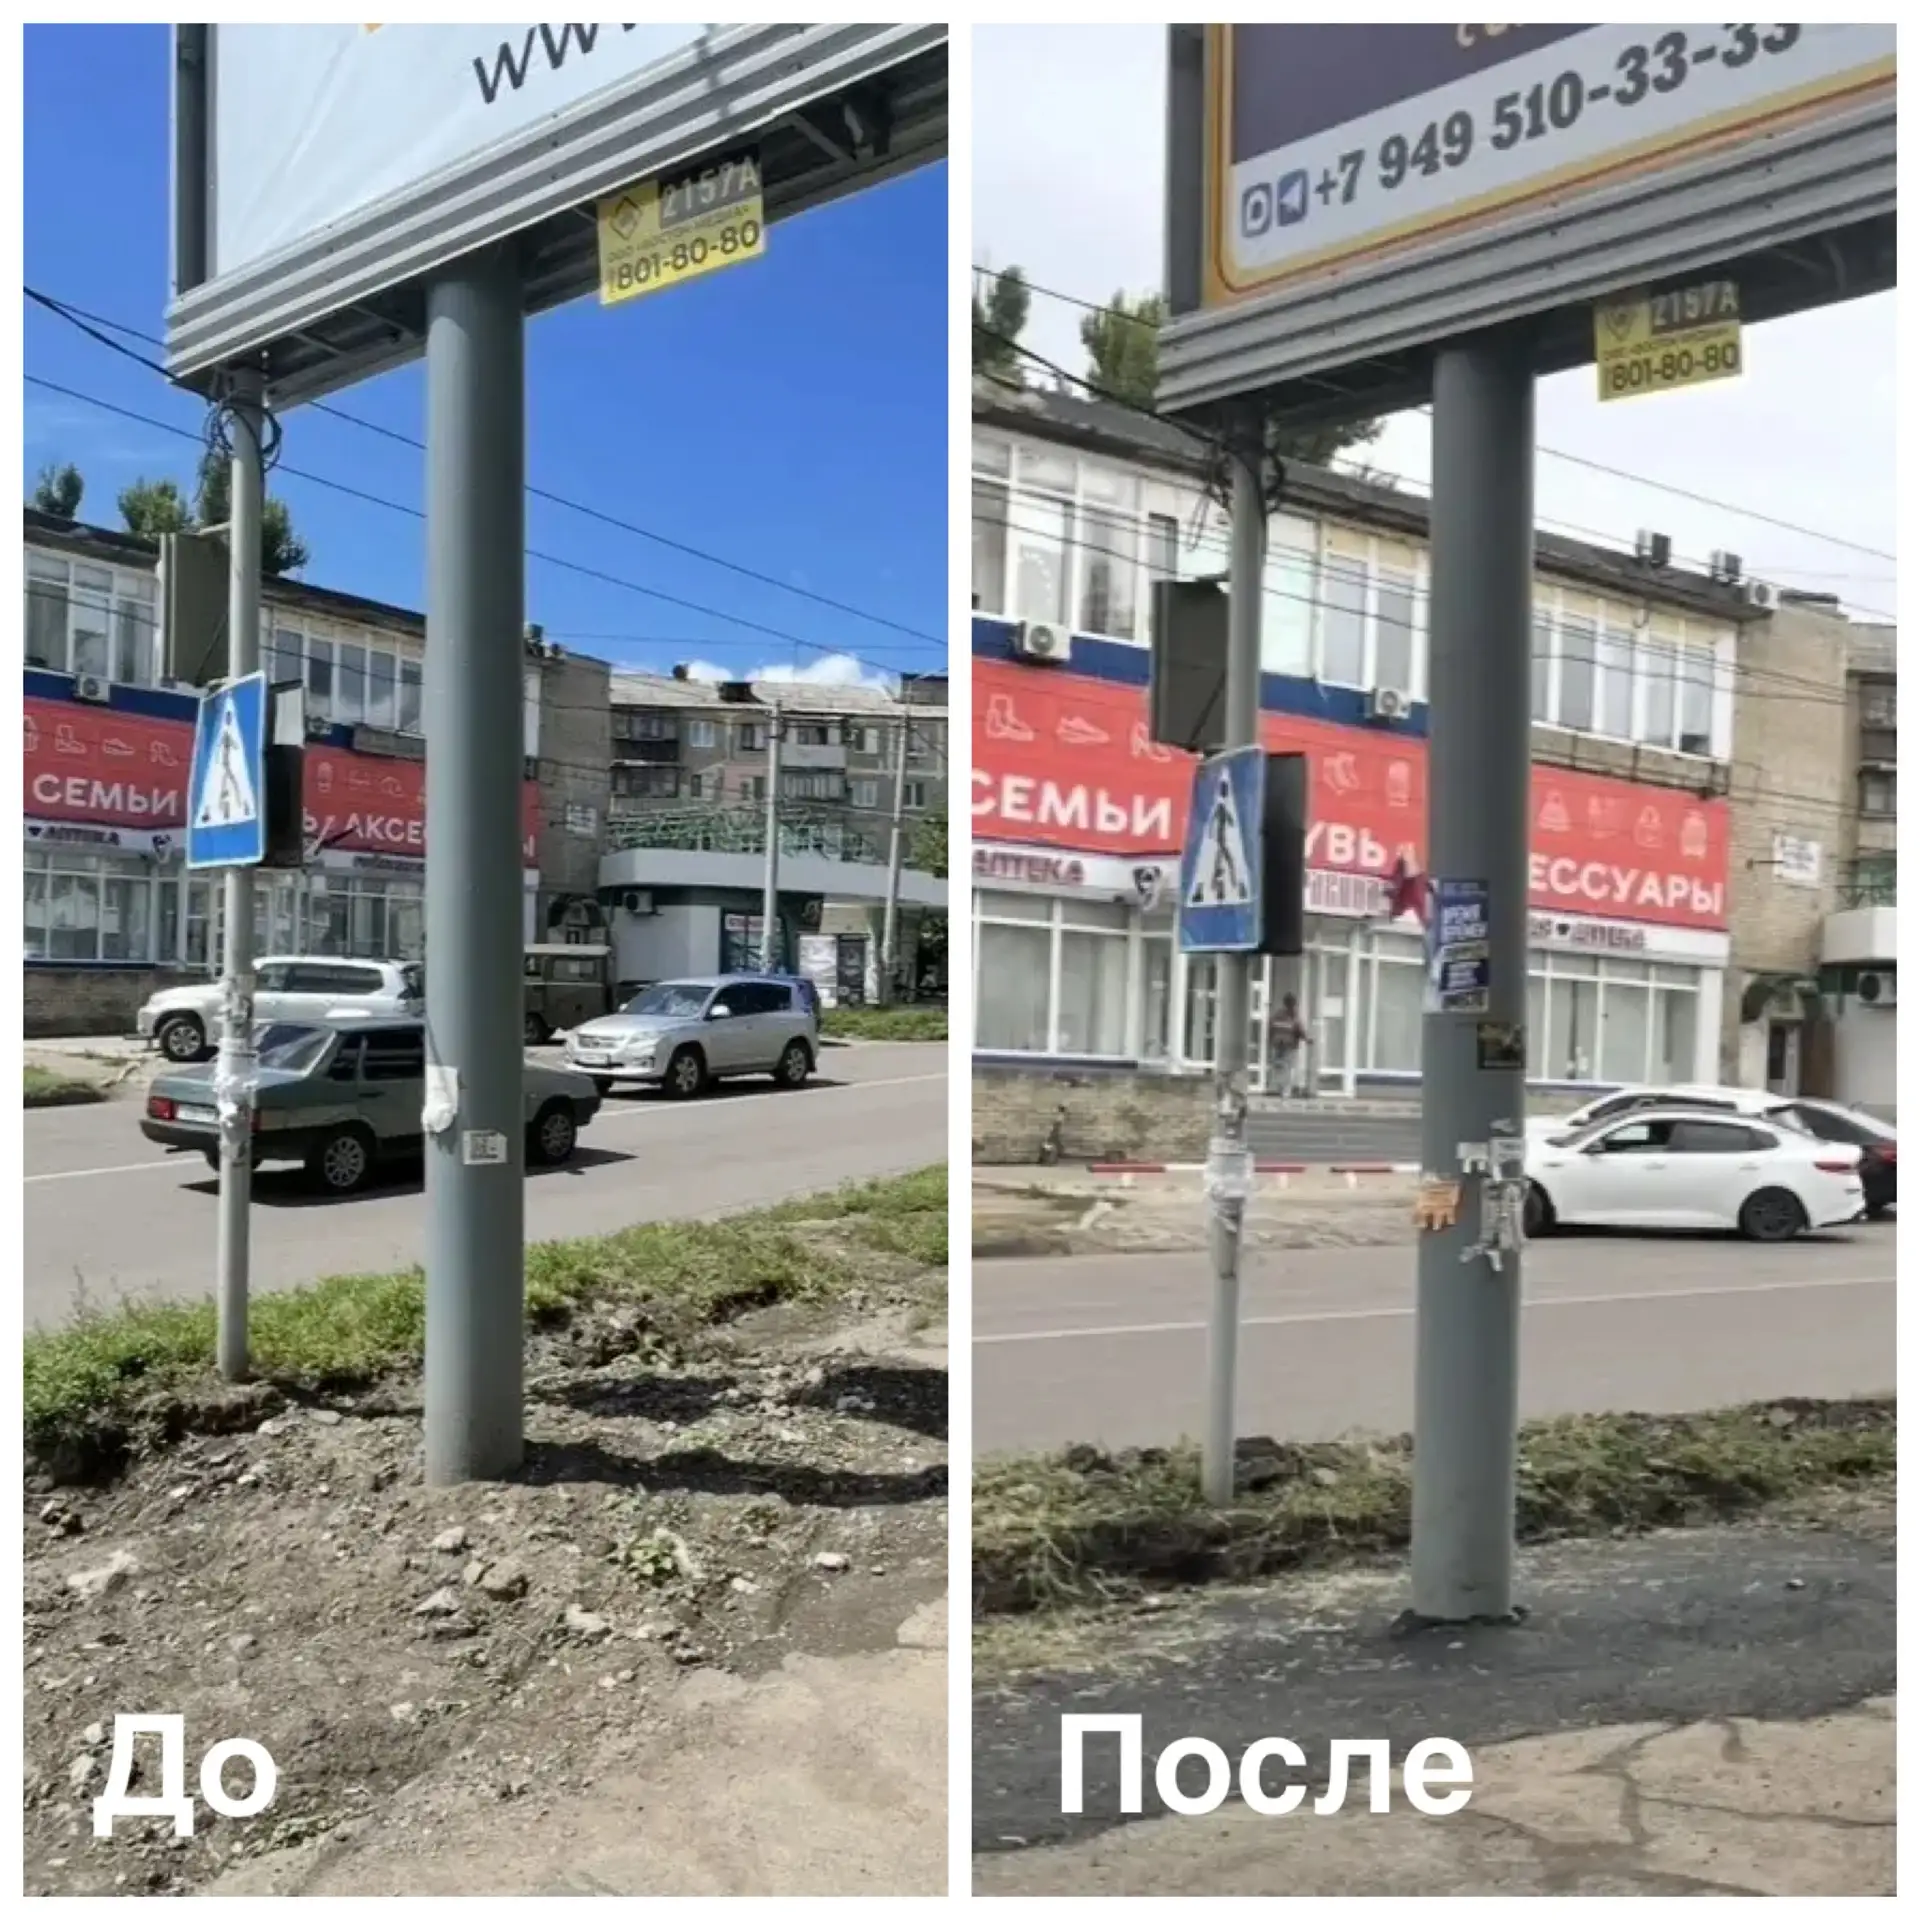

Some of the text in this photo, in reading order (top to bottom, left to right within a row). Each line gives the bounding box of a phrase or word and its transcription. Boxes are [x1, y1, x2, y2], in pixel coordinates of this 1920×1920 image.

[1315, 23, 1802, 206] +7 949 510-33-33
[662, 156, 760, 219] 2157A
[617, 219, 760, 290] 801-80-80
[1612, 341, 1740, 392] 801-80-80
[32, 773, 178, 817] СЕМЬИ
[972, 769, 1172, 840] СЕМЬИ
[1529, 852, 1724, 915] ЕССУАРЫ
